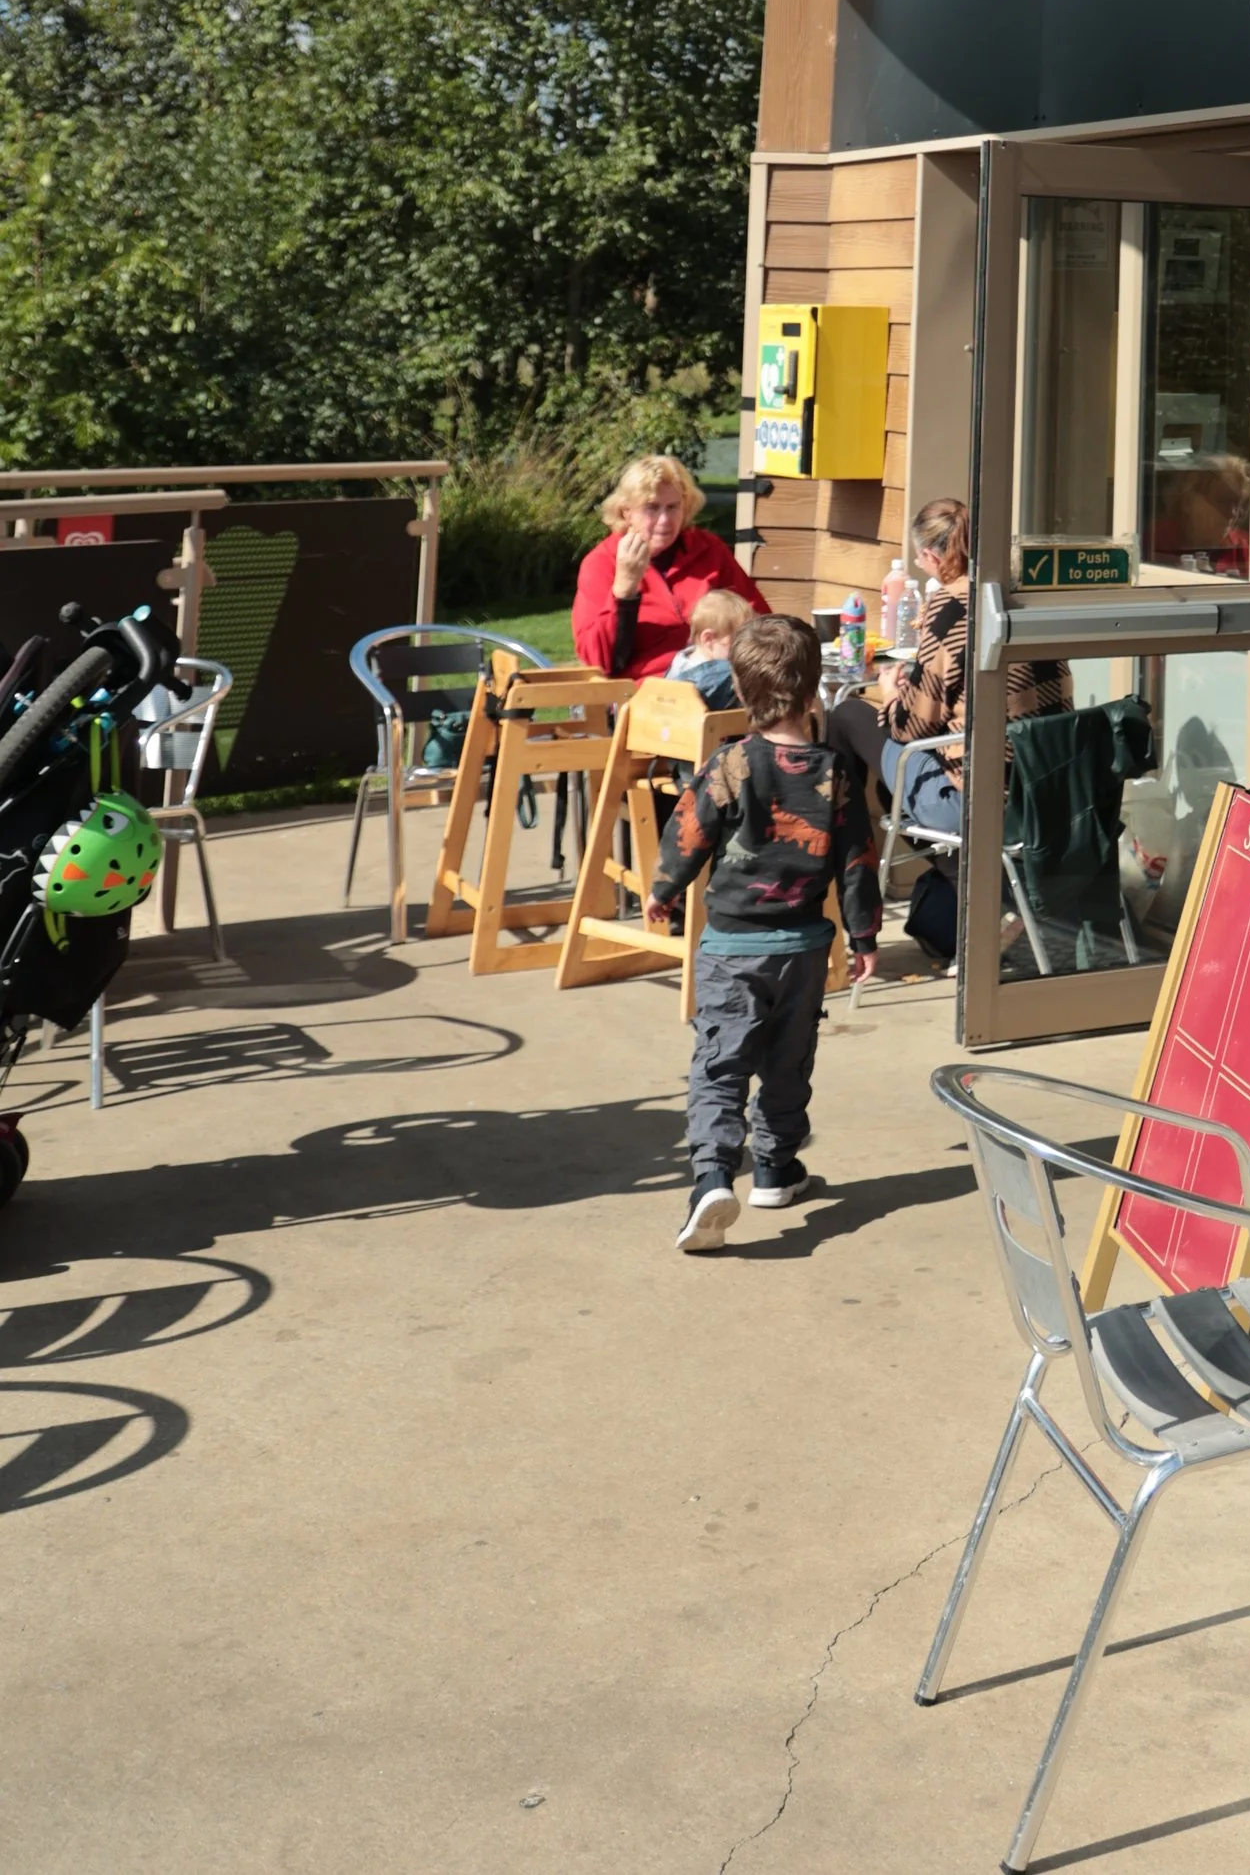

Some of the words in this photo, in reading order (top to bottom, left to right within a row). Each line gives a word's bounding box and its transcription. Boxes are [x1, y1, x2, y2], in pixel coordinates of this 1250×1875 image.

[1077, 551, 1110, 564] Push
[1068, 568, 1082, 580] to
[1086, 568, 1119, 582] open
